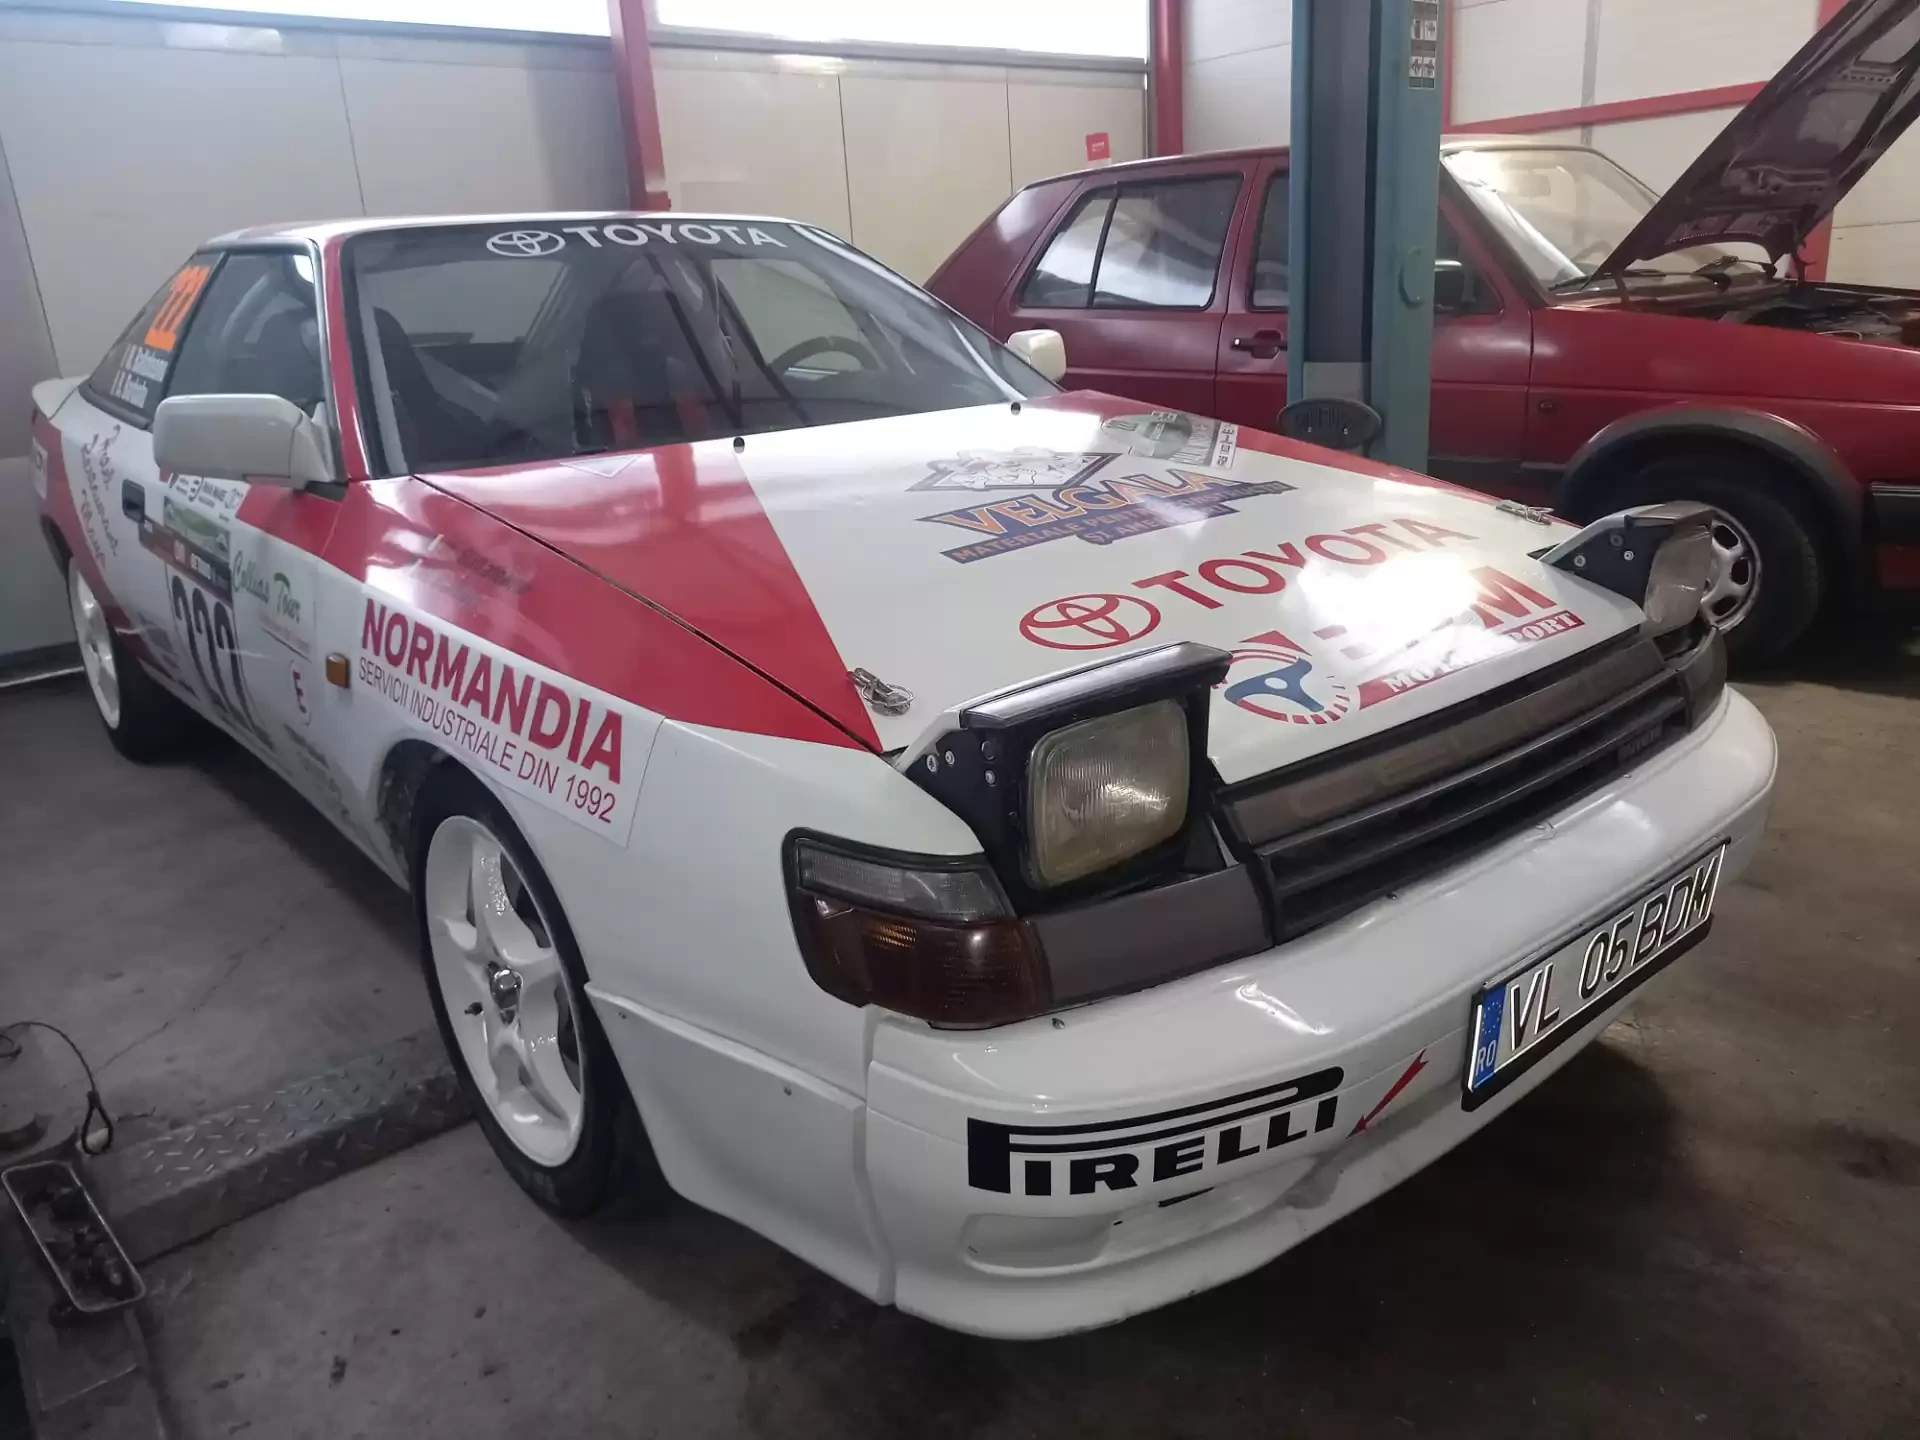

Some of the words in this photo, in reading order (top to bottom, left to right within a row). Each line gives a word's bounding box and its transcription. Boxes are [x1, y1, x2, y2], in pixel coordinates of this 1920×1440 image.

[563, 223, 788, 249] TOYOTA
[935, 469, 1239, 537] VELGALA
[1132, 518, 1481, 609] TOYOTA
[359, 656, 408, 705] SERVICII
[410, 690, 518, 771] INDUSTRIALE
[517, 751, 560, 794] DIN
[566, 774, 617, 824] 1992
[361, 598, 623, 785] NORMANDIA
[1510, 961, 1560, 1052] VL
[1577, 911, 1635, 1000] 05
[1630, 855, 1719, 967] BDM
[1475, 1039, 1497, 1077] RO
[968, 1066, 1345, 1196] PIRELLI
